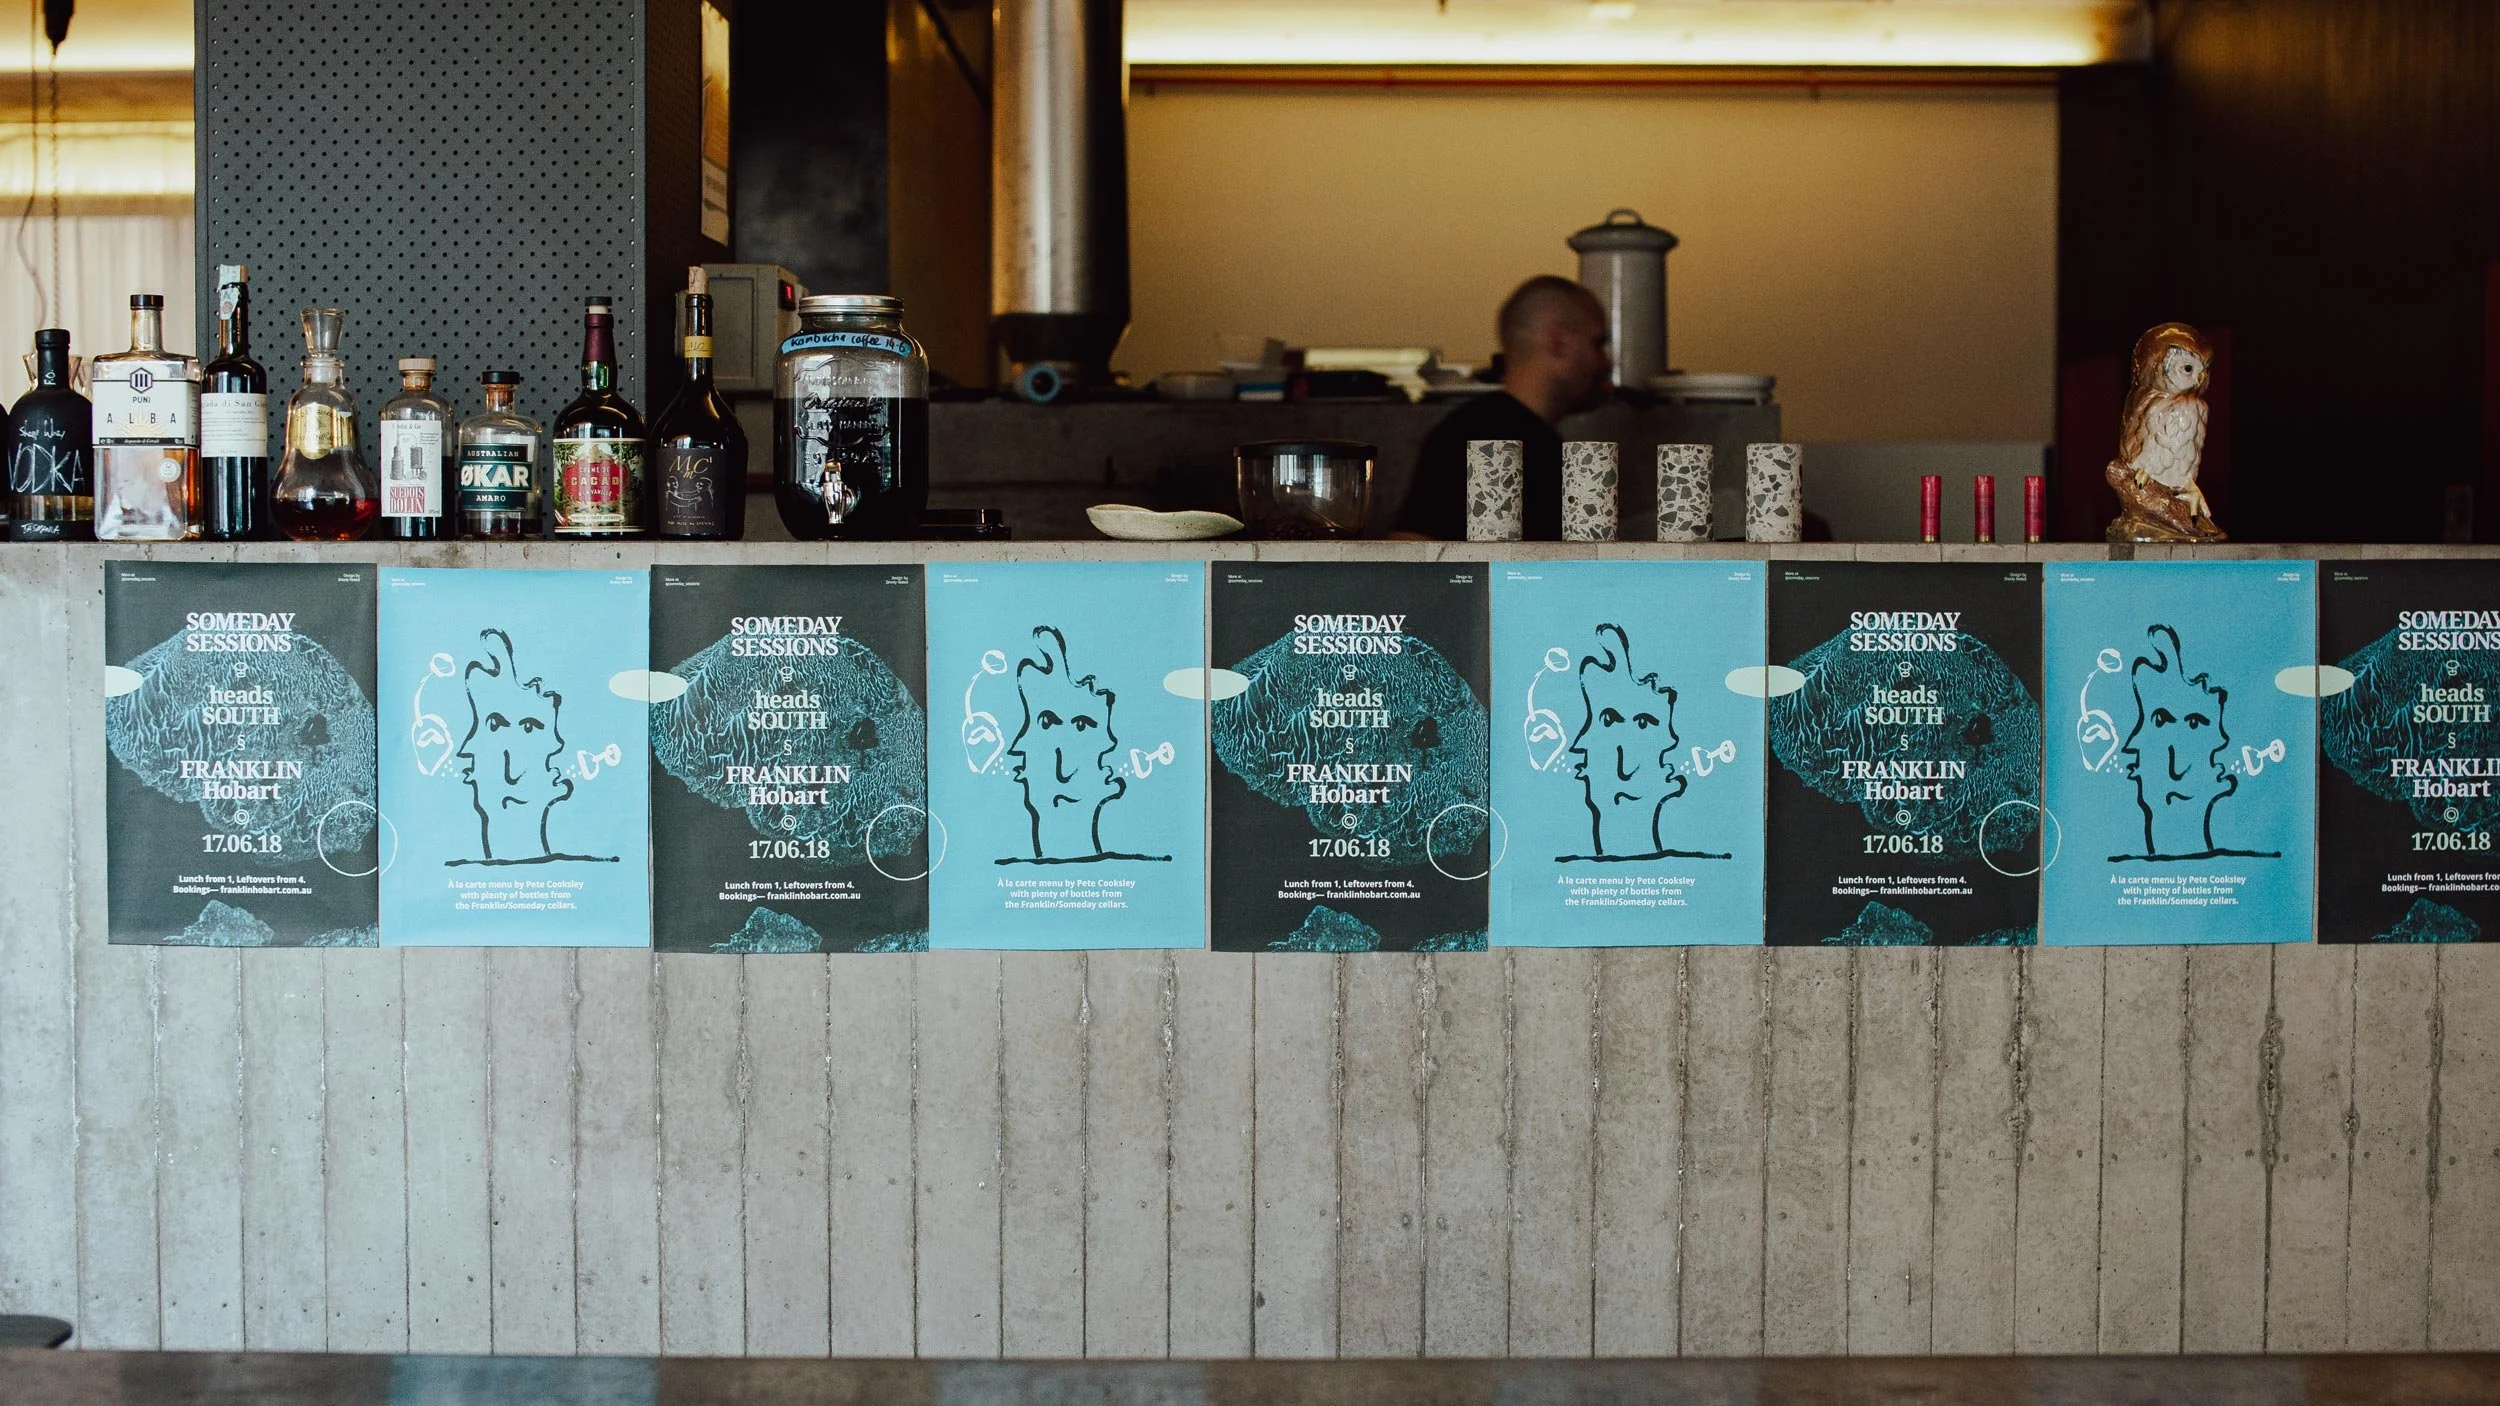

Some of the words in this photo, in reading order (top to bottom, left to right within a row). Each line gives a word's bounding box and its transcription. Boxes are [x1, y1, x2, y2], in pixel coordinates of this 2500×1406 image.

[851, 335, 882, 347] coffee
[132, 396, 151, 404] PUNI
[8, 443, 85, 494] VODKA
[460, 464, 529, 488] ØKAR
[571, 476, 620, 486] CACAO
[390, 487, 424, 499] SUEDOIS
[390, 498, 424, 513] DOLIN
[186, 613, 295, 631] SOMEDAY
[731, 616, 842, 636] SOMEDAY
[1294, 615, 1406, 633] SOMEDAY
[1850, 612, 1961, 631] SOMEDAY
[186, 633, 291, 652] SESSIONS
[731, 637, 838, 657] SESSIONS
[1294, 636, 1402, 654] SESSIONS
[1850, 633, 1956, 651] SESSIONS
[2398, 631, 2500, 650] SESSIONS
[209, 685, 273, 704] heads
[755, 689, 820, 709] heads
[1317, 688, 1383, 707] heads
[1872, 685, 1937, 704] heads
[2420, 683, 2484, 702] heads
[202, 707, 280, 725] SOUTH
[748, 711, 827, 730] SOUTH
[1310, 710, 1389, 728] SOUTH
[1865, 706, 1944, 725] SOUTH
[2413, 704, 2491, 723] SOUTH
[180, 760, 303, 779] FRANKLIN
[726, 765, 851, 785] FRANKLIN
[1287, 764, 1412, 783] FRANKLIN
[1842, 761, 1966, 779] FRANKLIN
[2391, 758, 2500, 777] FRANKLI
[203, 781, 281, 800] Hobart
[749, 786, 829, 805] Hobart
[1309, 785, 1390, 803] Hobart
[1864, 781, 1944, 800] Hobart
[2413, 779, 2491, 797] Hobart
[202, 834, 282, 853] 17.06.18
[748, 840, 830, 859] 17.06.18
[1308, 838, 1390, 857] 17.06.18
[1862, 835, 1944, 854] 17.06.18
[2411, 832, 2491, 851] 17.06.18
[179, 875, 204, 883] Lunch
[205, 875, 225, 883] from
[236, 875, 275, 883] Leftovers
[276, 875, 296, 883] from
[725, 881, 750, 889] Lunch
[752, 881, 772, 889] from
[784, 881, 823, 889] Leftovers
[824, 881, 845, 889] from
[1077, 879, 1095, 887] Pete
[1098, 879, 1136, 889] Cooksley
[1284, 880, 1310, 888] Lunch
[1311, 880, 1332, 888] from
[1343, 880, 1383, 888] Leftovers
[1384, 880, 1405, 888] from
[1637, 877, 1656, 885] Pete
[1658, 877, 1696, 886] Cooksley
[1838, 876, 1864, 884] Lunch
[1865, 876, 1885, 884] from
[1897, 876, 1935, 884] Leftovers
[1937, 876, 1957, 884] from
[2189, 876, 2207, 884] Pete
[2209, 875, 2247, 885] Cooksley
[2388, 873, 2413, 881] Lunch
[2414, 873, 2434, 881] from
[2445, 872, 2483, 880] Leftovers
[2485, 872, 2500, 880] fro
[220, 886, 312, 894] franklinhobart.com.au
[767, 892, 861, 900] franklinhobart.com.au
[1010, 889, 1029, 897] with
[1031, 890, 1058, 899] plenty
[1070, 890, 1100, 898] bottles
[1102, 890, 1122, 898] from
[1326, 891, 1420, 899] franklinhobart.com.au
[1570, 887, 1589, 895] with
[1591, 887, 1618, 897] plenty
[1630, 887, 1660, 895] bottles
[1662, 887, 1682, 895] from
[1880, 887, 1972, 895] franklinhobart.com.au
[2123, 886, 2142, 894] with
[2144, 886, 2171, 896] plenty
[2182, 886, 2212, 894] bottles
[2213, 886, 2233, 894] from
[1005, 900, 1019, 908] the
[2118, 897, 2132, 905] the
